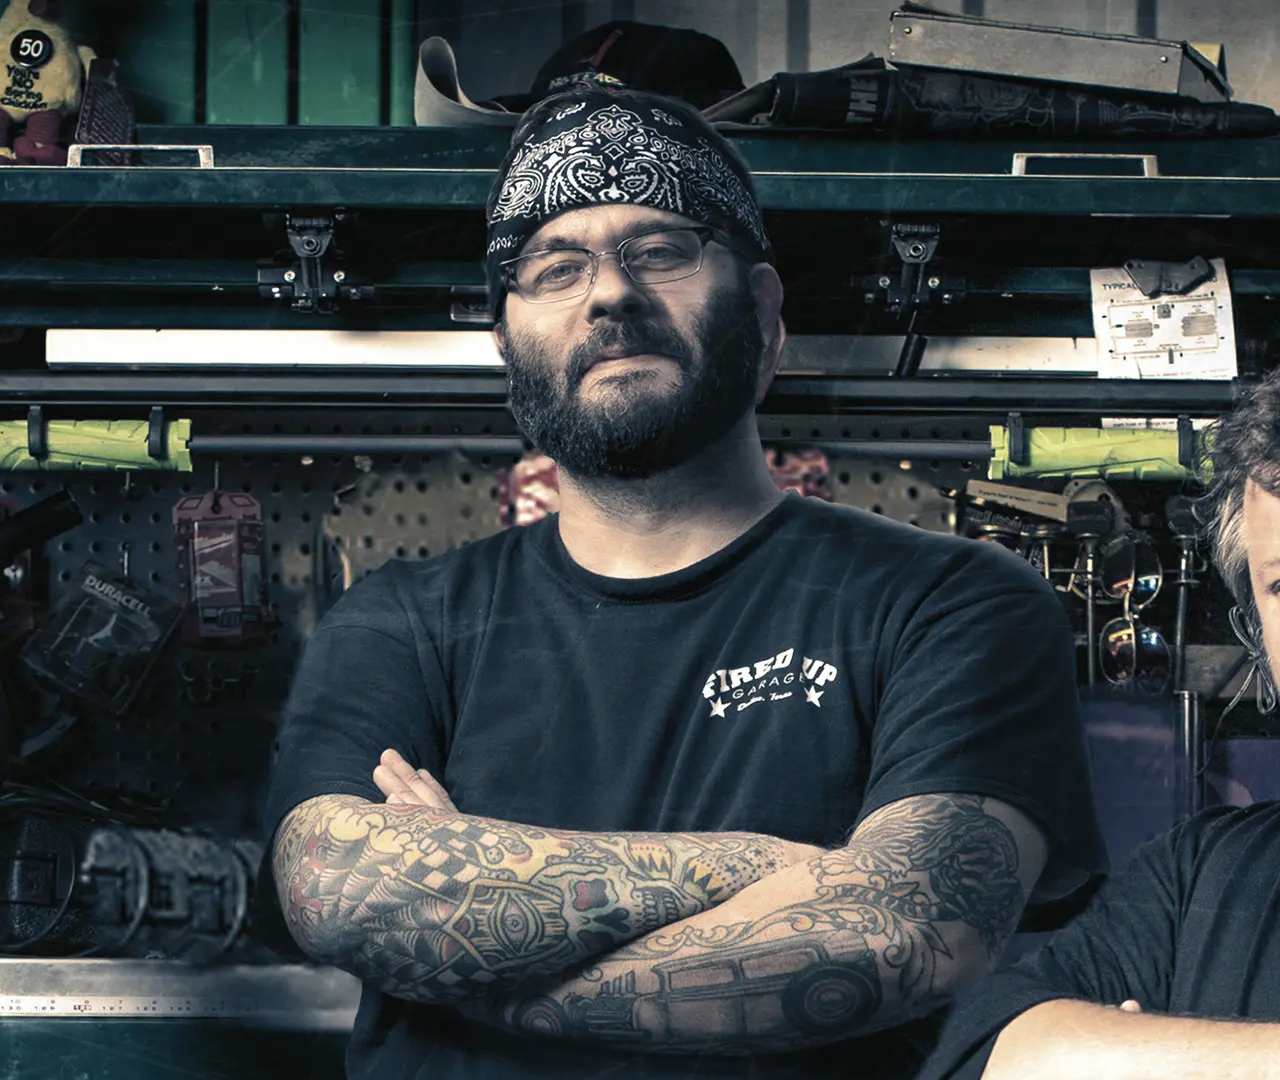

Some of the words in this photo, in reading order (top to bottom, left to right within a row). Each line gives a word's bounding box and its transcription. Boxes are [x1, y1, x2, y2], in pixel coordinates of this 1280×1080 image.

[19, 38, 44, 57] 50
[84, 574, 152, 618] DURACELL
[702, 648, 795, 699] FIRED
[802, 656, 838, 687] UP
[732, 672, 805, 699] GARAGE
